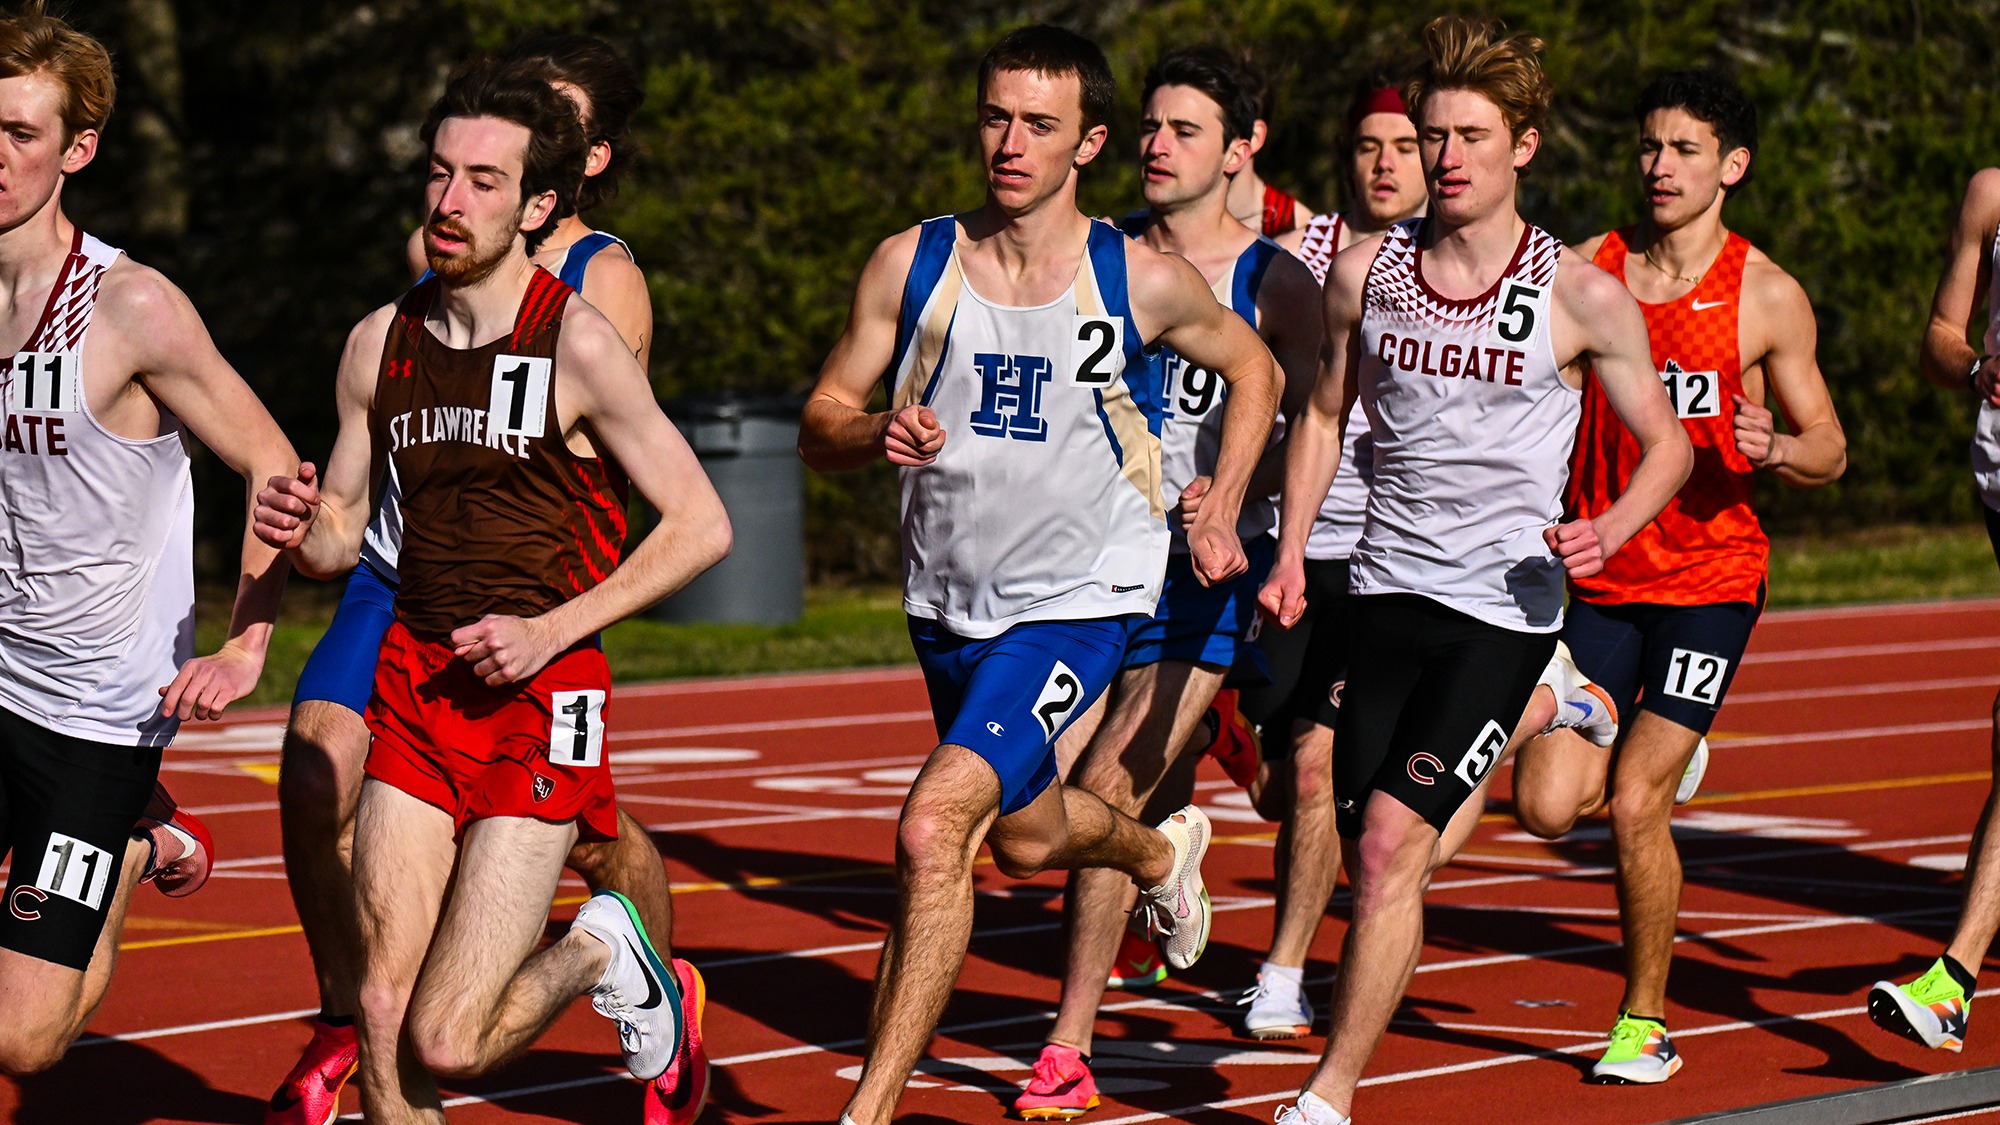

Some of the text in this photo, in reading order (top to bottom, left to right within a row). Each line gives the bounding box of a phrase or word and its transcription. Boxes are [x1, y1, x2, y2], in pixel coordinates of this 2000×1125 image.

[1498, 284, 1540, 342] 5
[1076, 320, 1115, 382] 2
[1378, 332, 1525, 386] COLGATE
[18, 355, 62, 409] 11
[501, 362, 530, 430] 1
[970, 353, 1053, 442] H
[1179, 364, 1216, 416] 9
[1664, 374, 1711, 414] 12
[0, 414, 68, 456] ATE
[390, 411, 416, 452] ST.
[1675, 652, 1718, 700] 12
[562, 695, 587, 761] 1
[1038, 673, 1078, 736] 2
[1406, 752, 1445, 785] C
[1467, 728, 1505, 784] 5
[50, 840, 99, 902] 11
[10, 885, 48, 921] C
